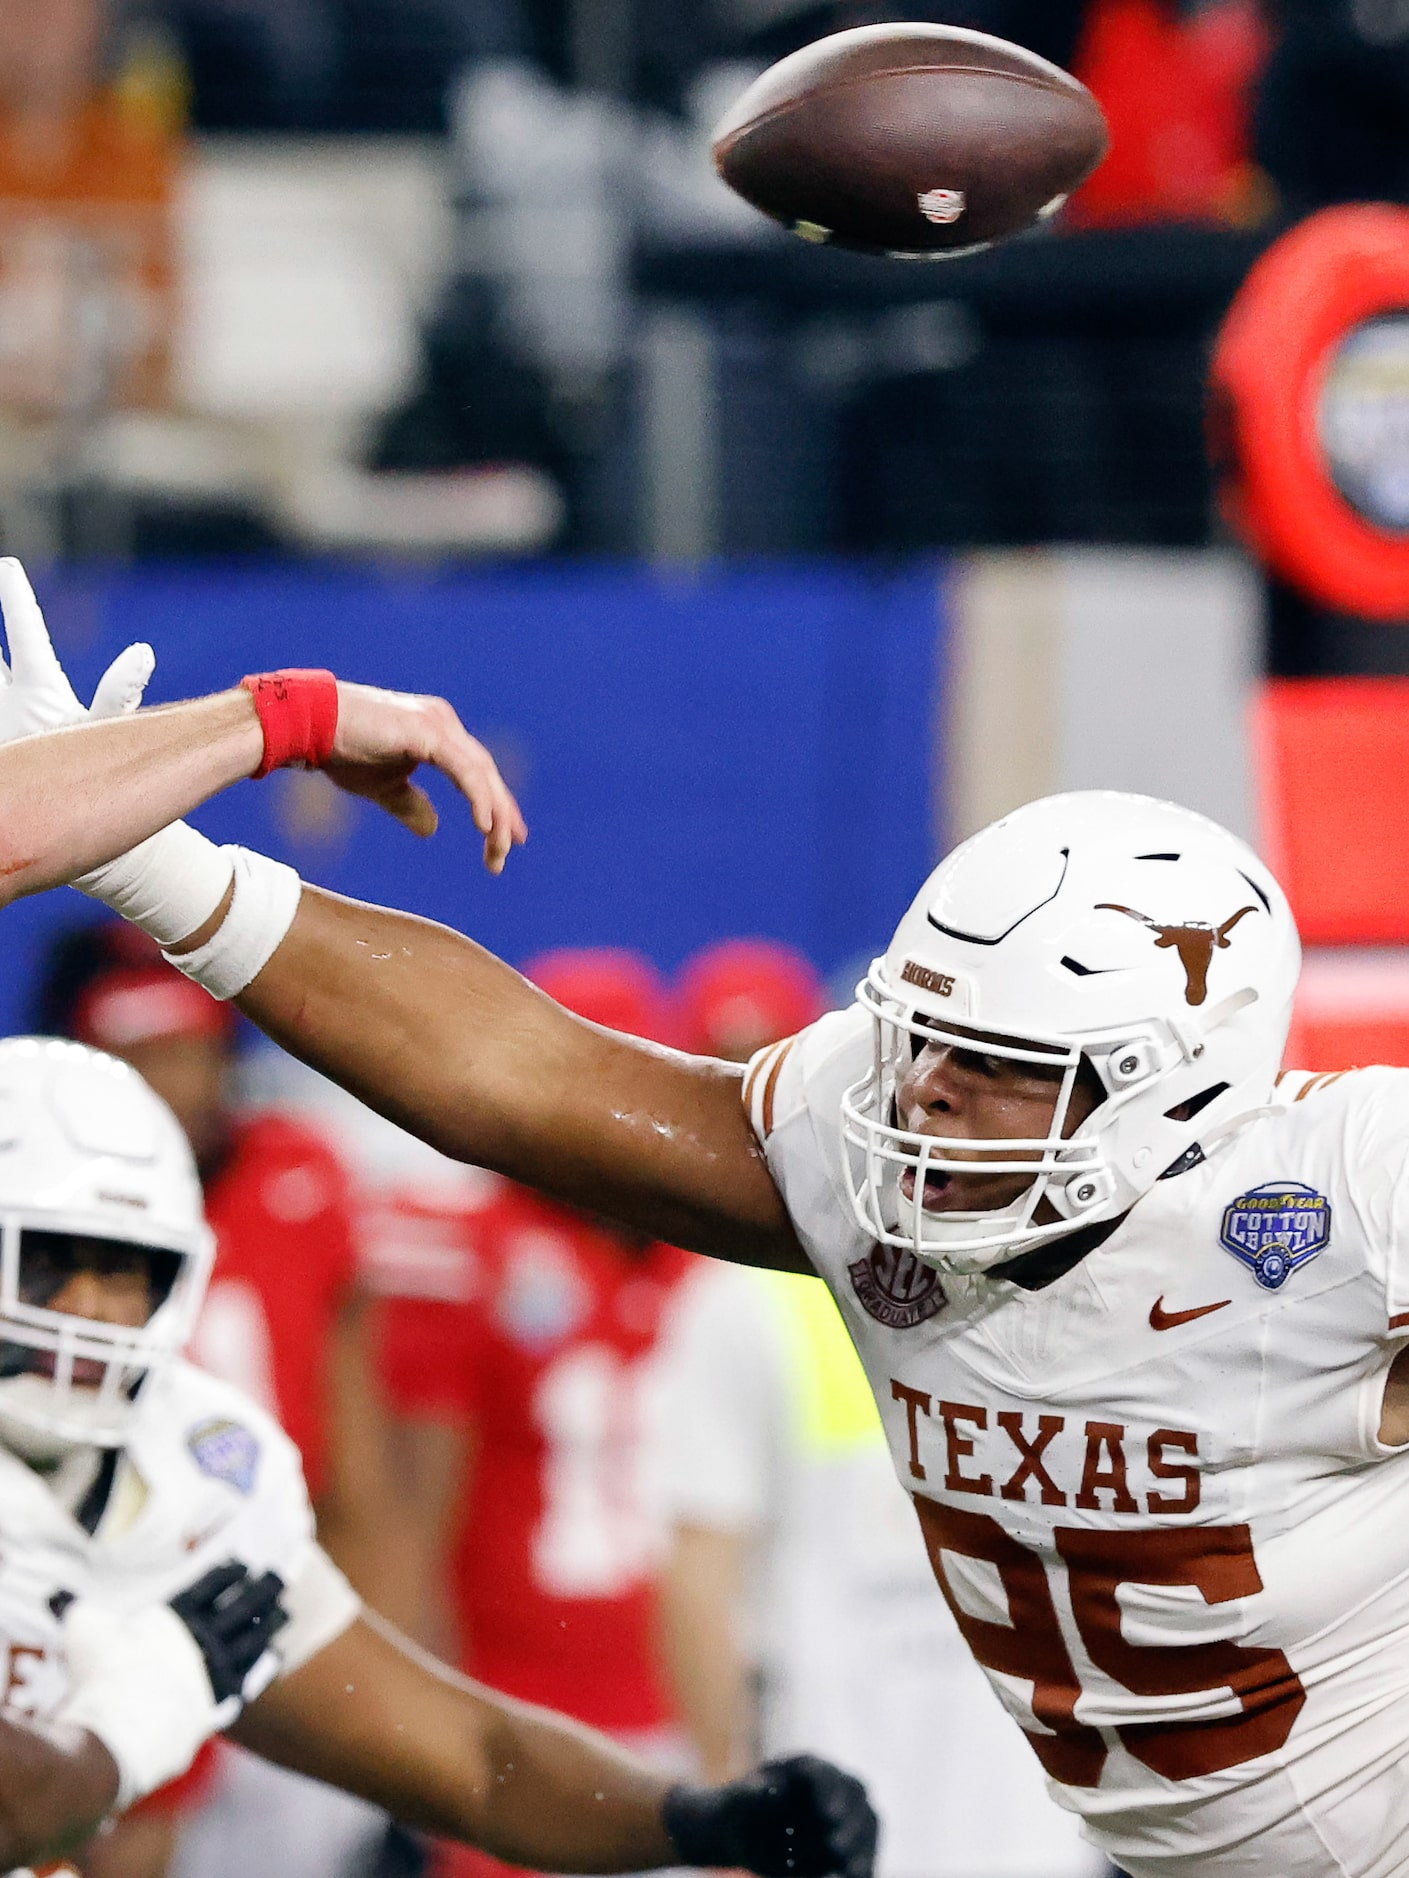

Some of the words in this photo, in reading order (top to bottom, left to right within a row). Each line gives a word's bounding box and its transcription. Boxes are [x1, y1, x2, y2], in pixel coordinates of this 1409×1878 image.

[1230, 1211, 1326, 1244] COTTON
[890, 1379, 1201, 1514] TEXAS
[912, 1491, 1307, 1788] 95
